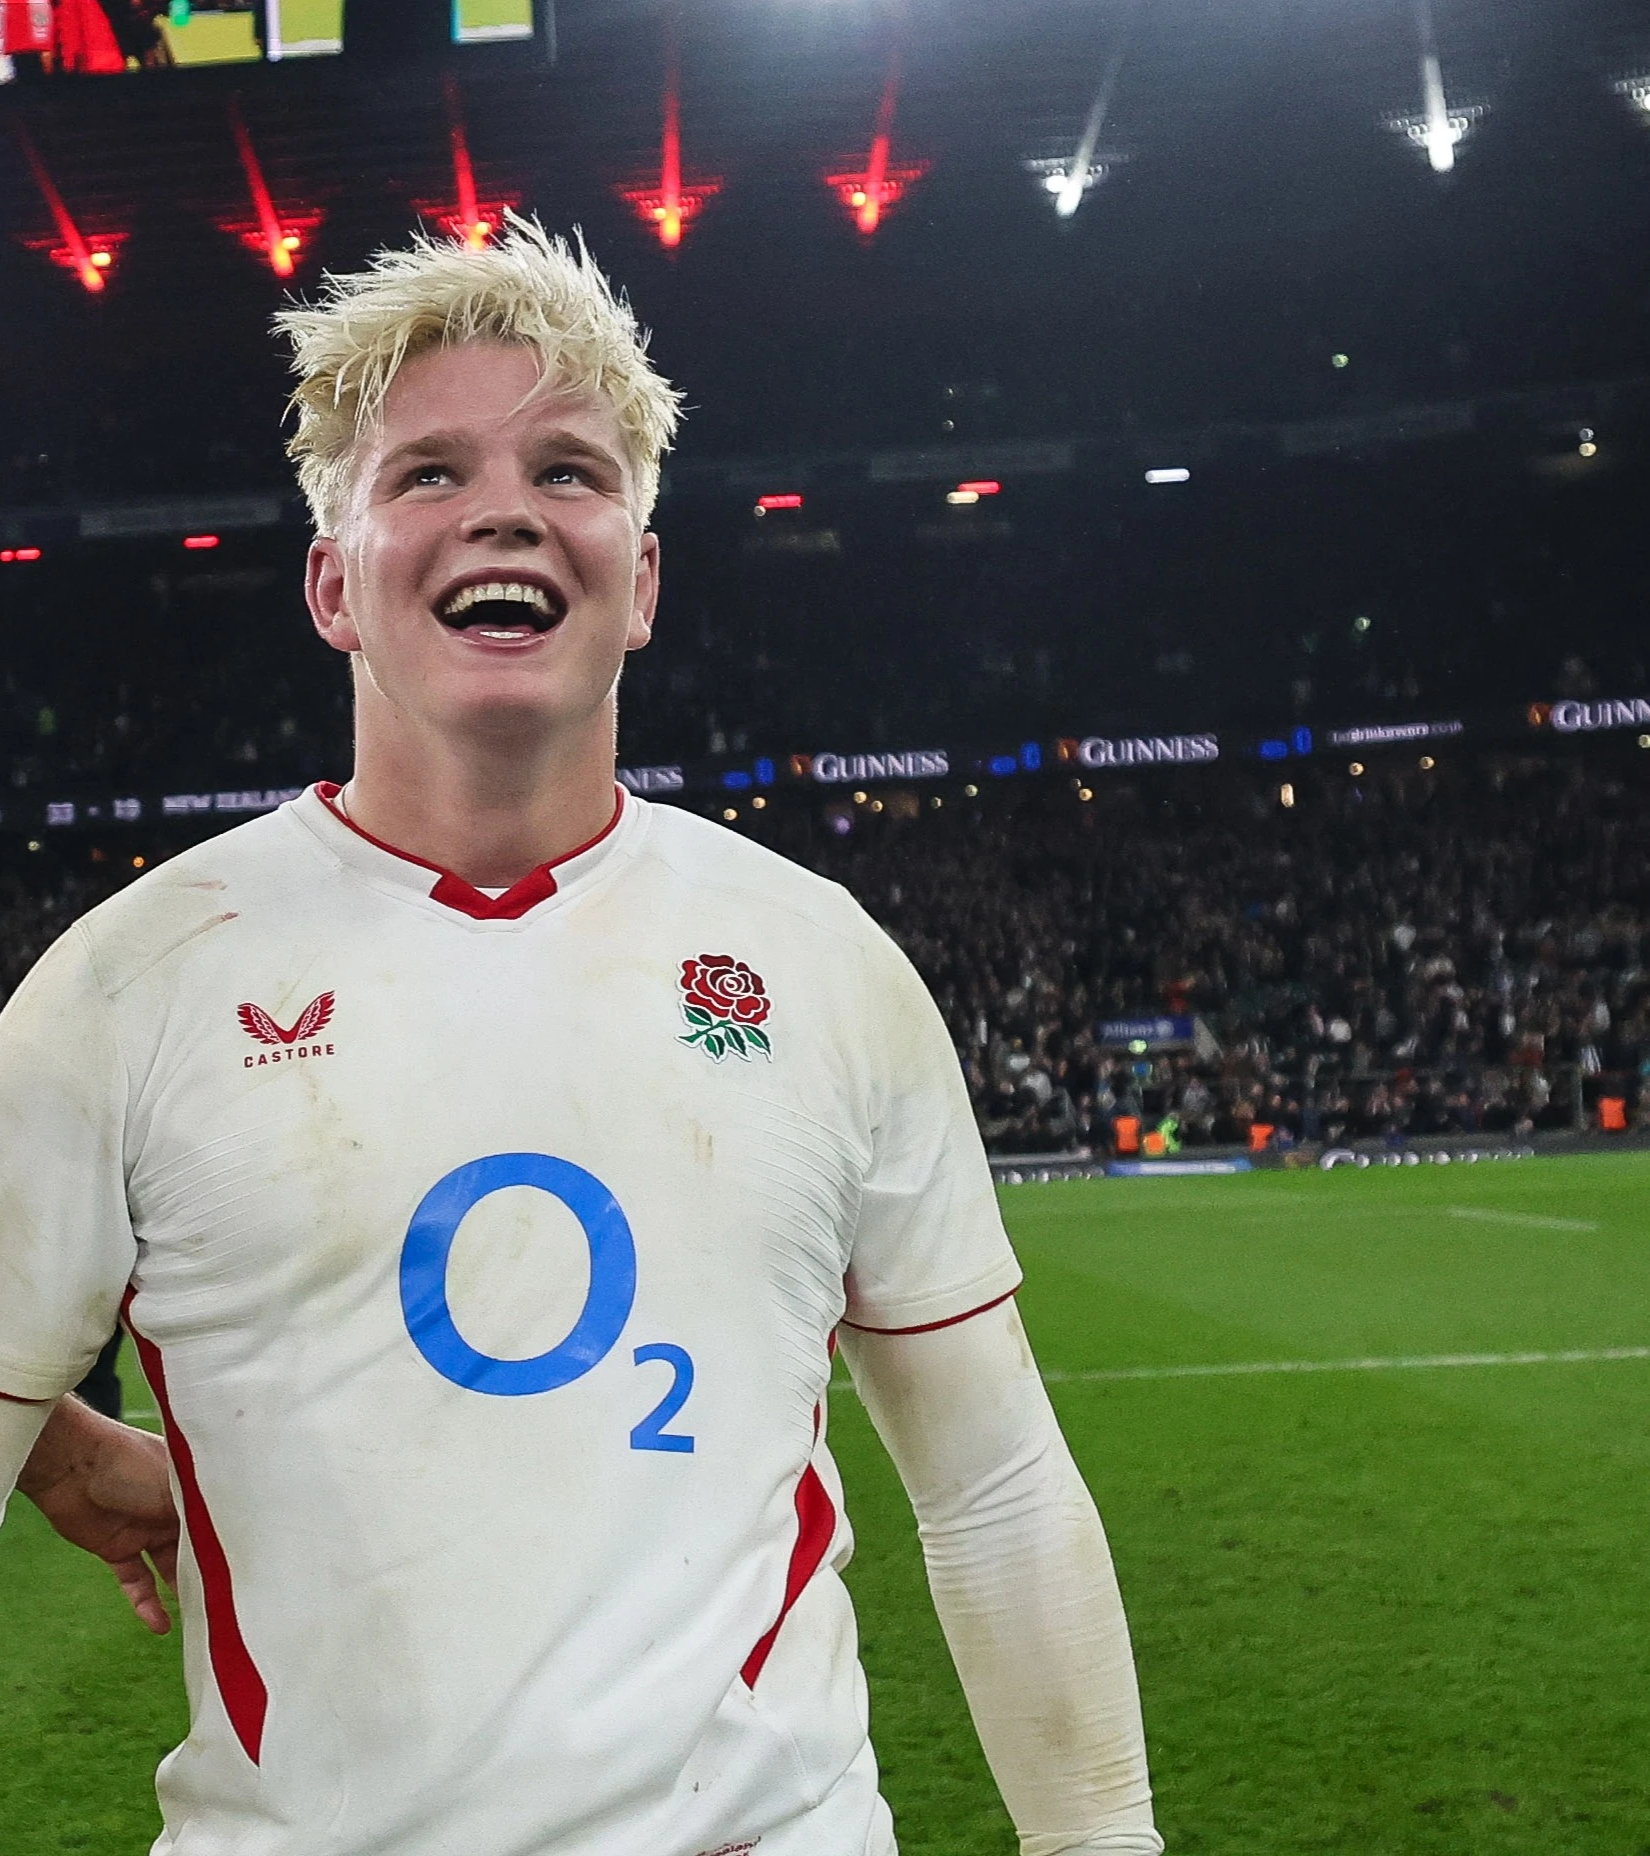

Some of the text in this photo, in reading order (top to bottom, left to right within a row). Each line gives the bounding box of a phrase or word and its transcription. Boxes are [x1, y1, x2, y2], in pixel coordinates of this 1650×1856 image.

[812, 750, 949, 783] GUINNESS
[1082, 733, 1219, 768] GUINNESS
[243, 1043, 335, 1069] CASTORE
[398, 1151, 695, 1453] O2
